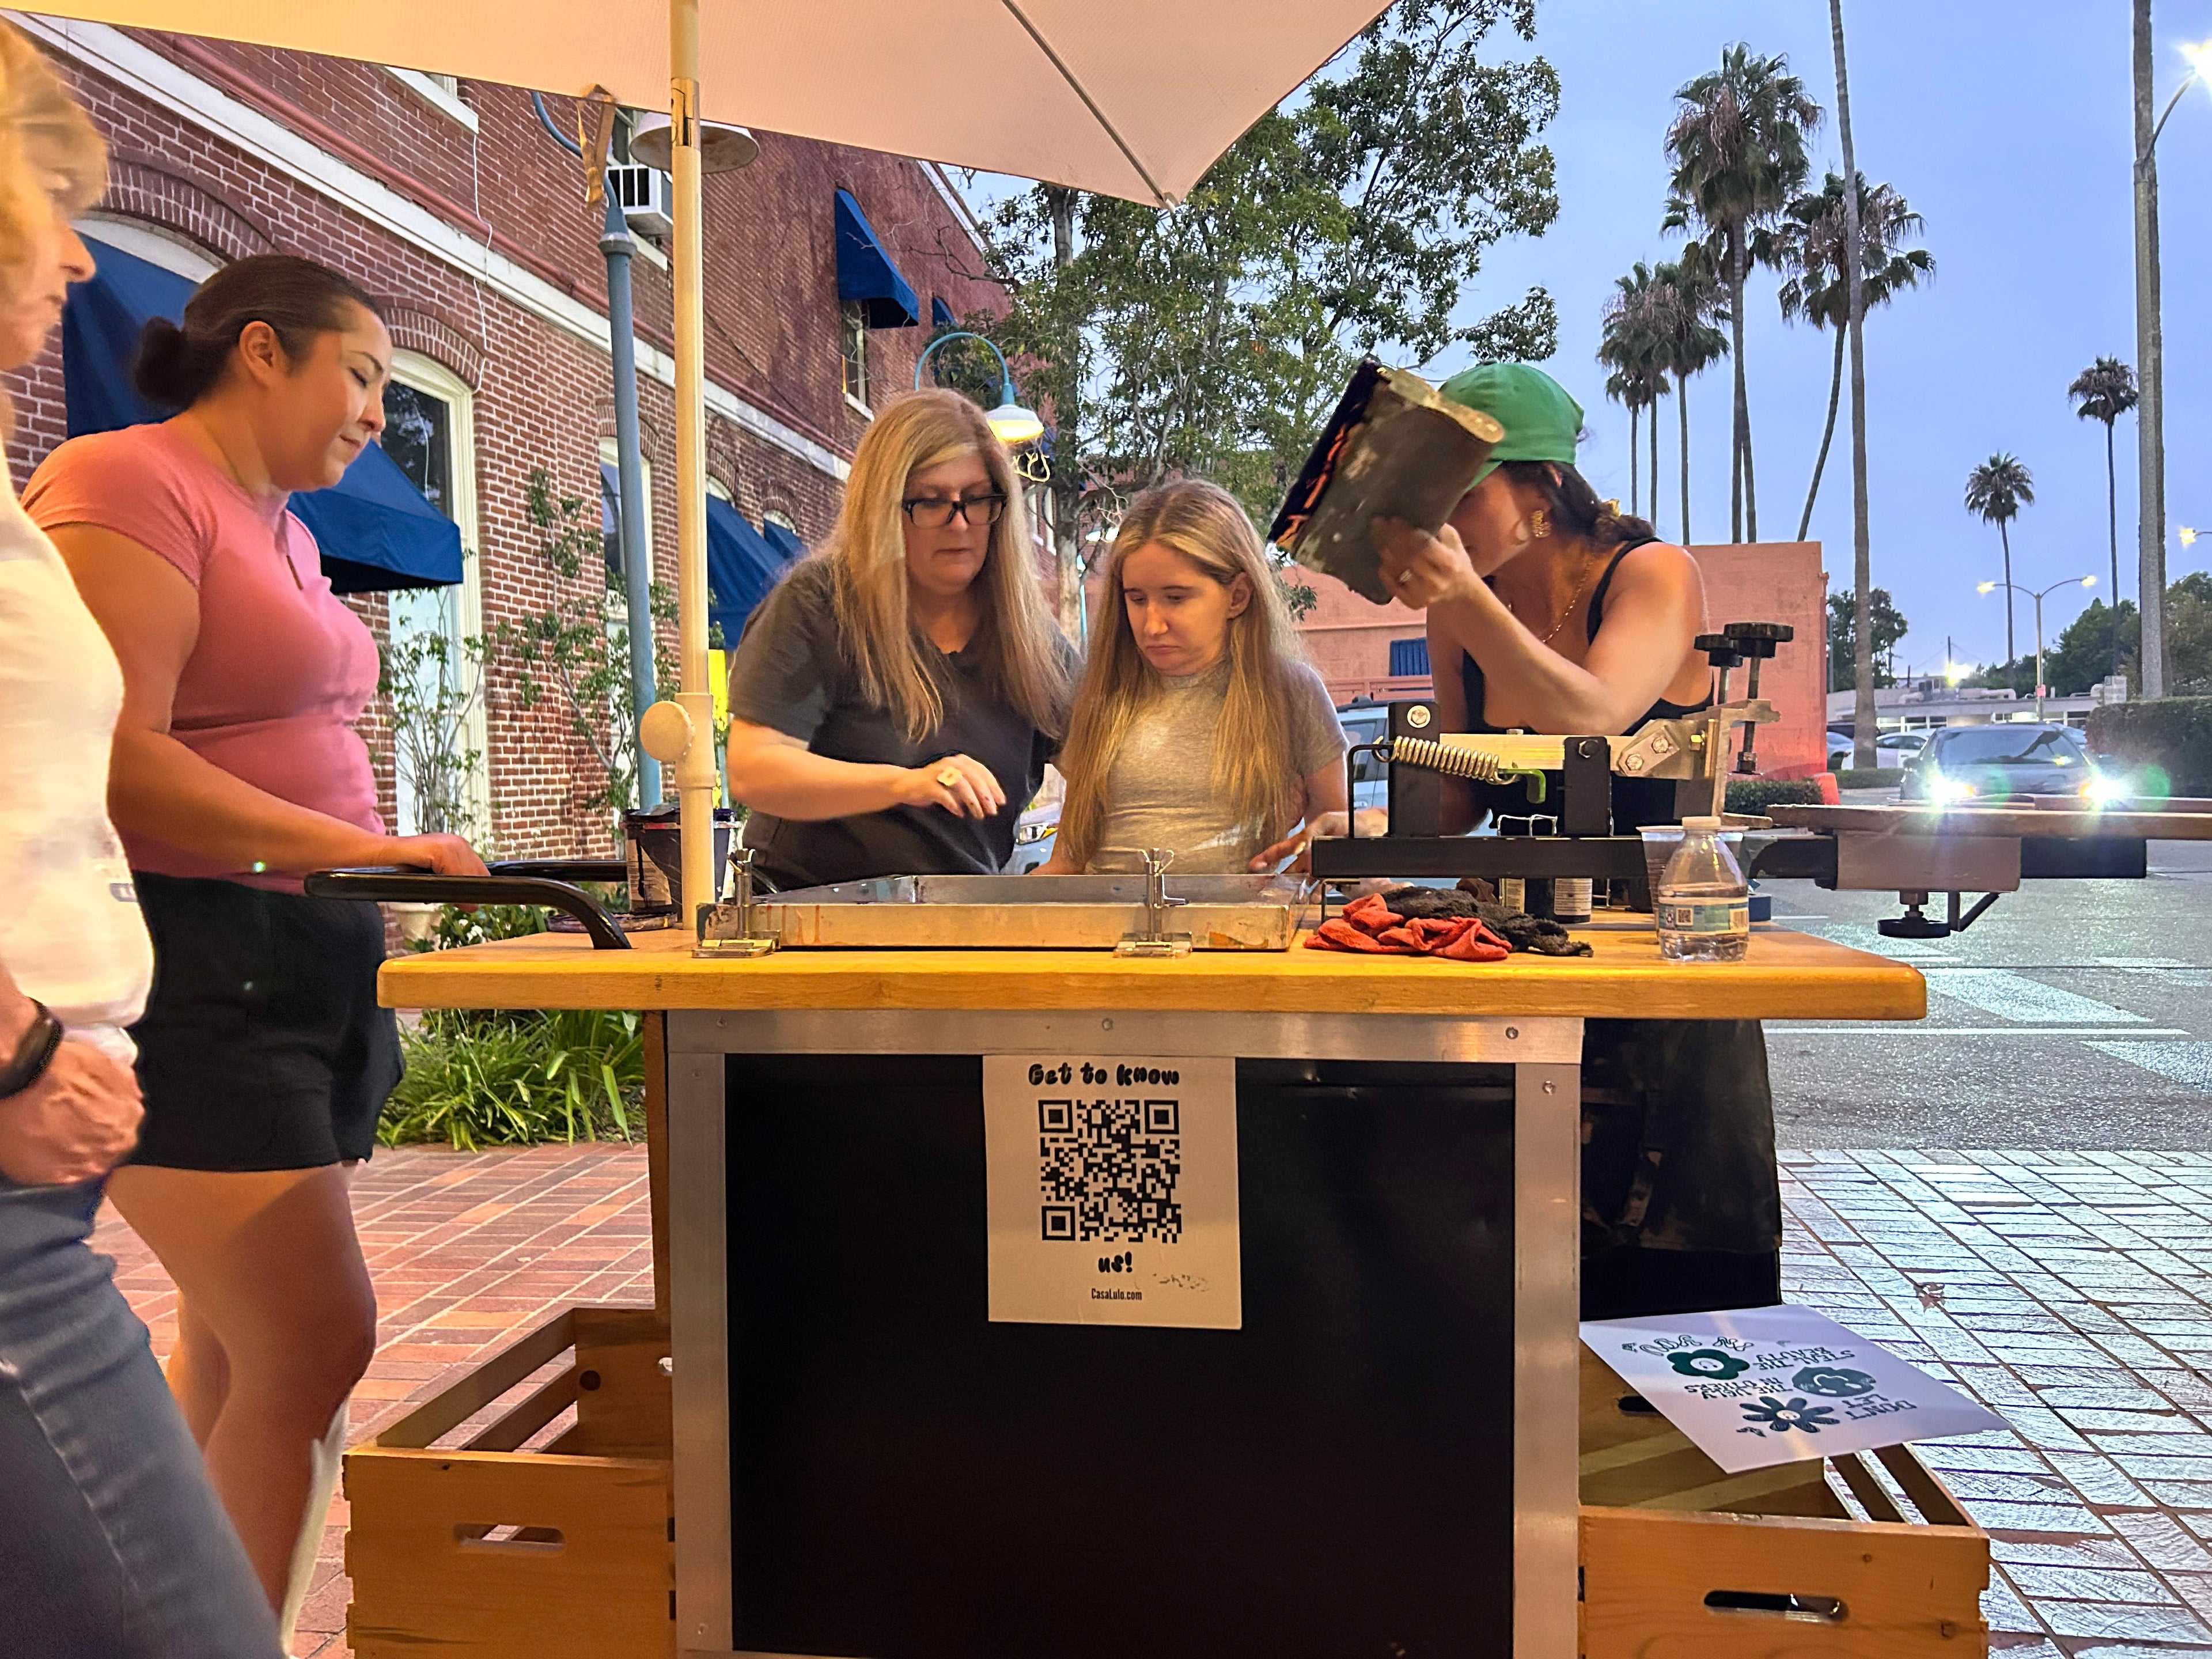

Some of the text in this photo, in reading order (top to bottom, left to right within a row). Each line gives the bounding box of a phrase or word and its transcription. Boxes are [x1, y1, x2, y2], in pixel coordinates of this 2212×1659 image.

[1029, 1062, 1180, 1086] Get to know
[1098, 1252, 1132, 1273] us!
[1091, 1288, 1142, 1300] CasaLulo.com
[1752, 1350, 1855, 1370] STEAL THE
[1756, 1347, 1831, 1362] BEAUTY
[1684, 1380, 1757, 1392] OTHERS
[1702, 1384, 1793, 1399] THE UGLY
[1842, 1394, 1889, 1408] LET
[1845, 1400, 1917, 1420] DON'T
